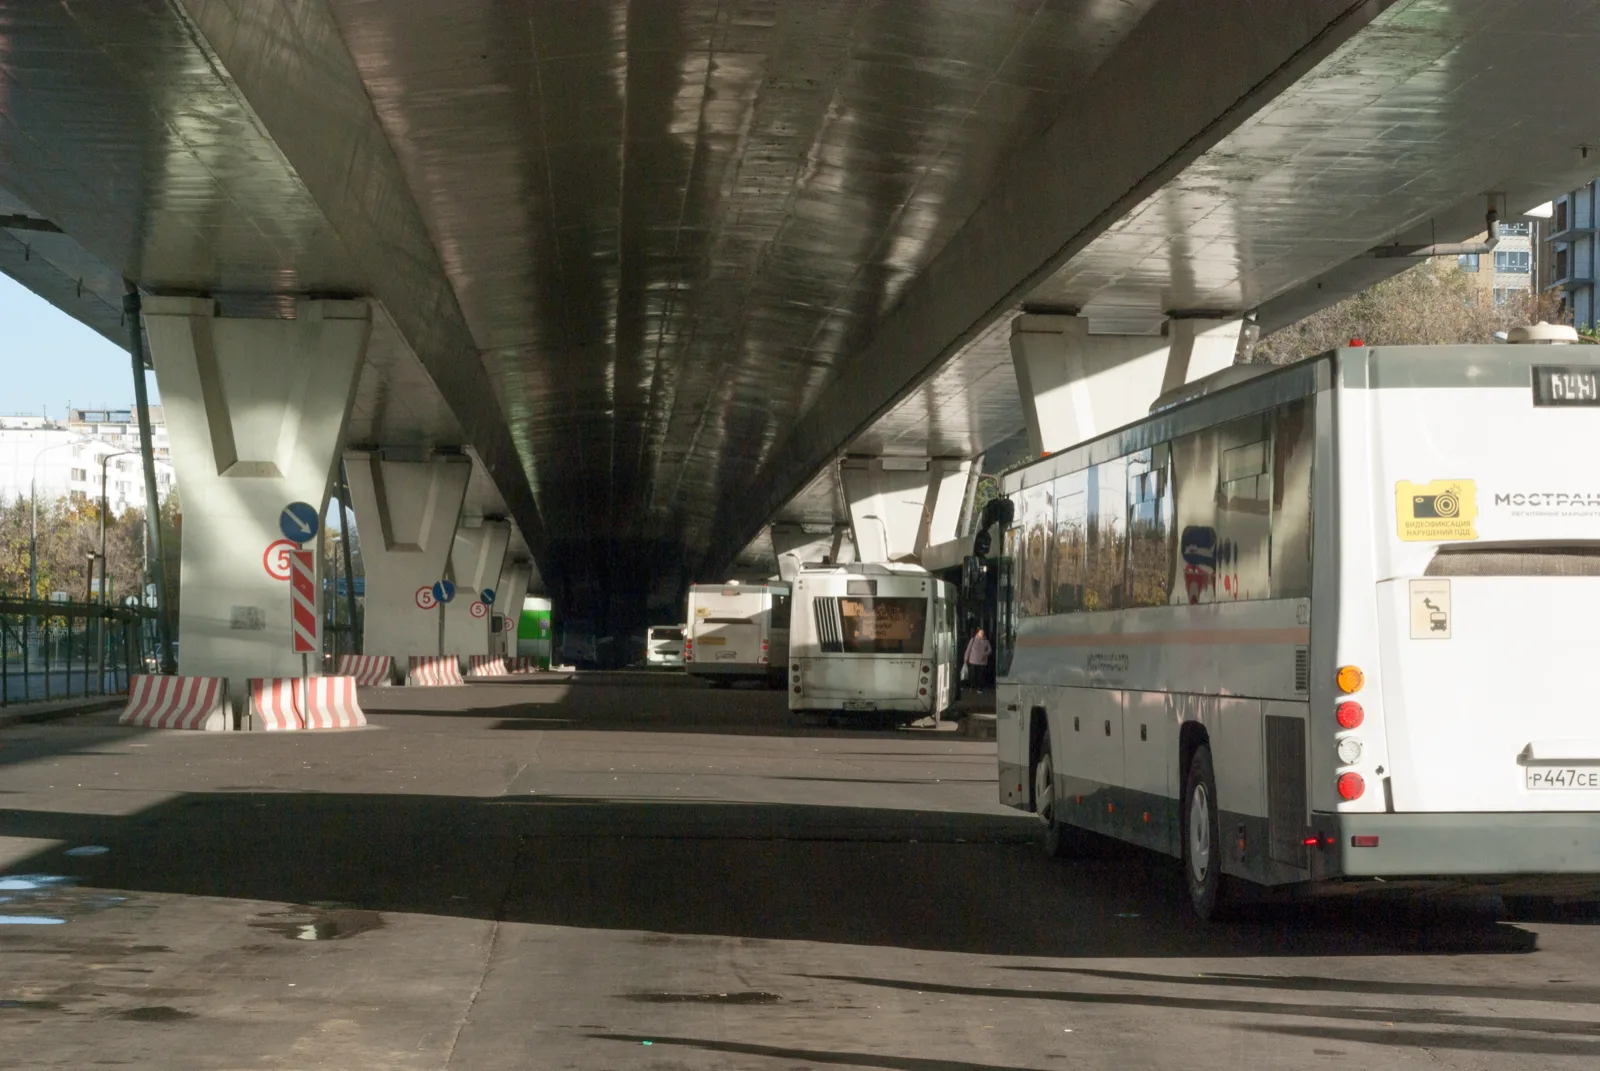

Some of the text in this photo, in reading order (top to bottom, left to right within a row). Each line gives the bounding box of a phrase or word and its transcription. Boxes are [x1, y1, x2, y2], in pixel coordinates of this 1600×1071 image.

[1405, 520, 1471, 529] ВИДЕОФИКСАЦИЯ
[1406, 529, 1452, 537] НАРУШЕНИЙ
[277, 549, 291, 570] 5
[423, 592, 431, 604] 5
[475, 605, 482, 614] 5
